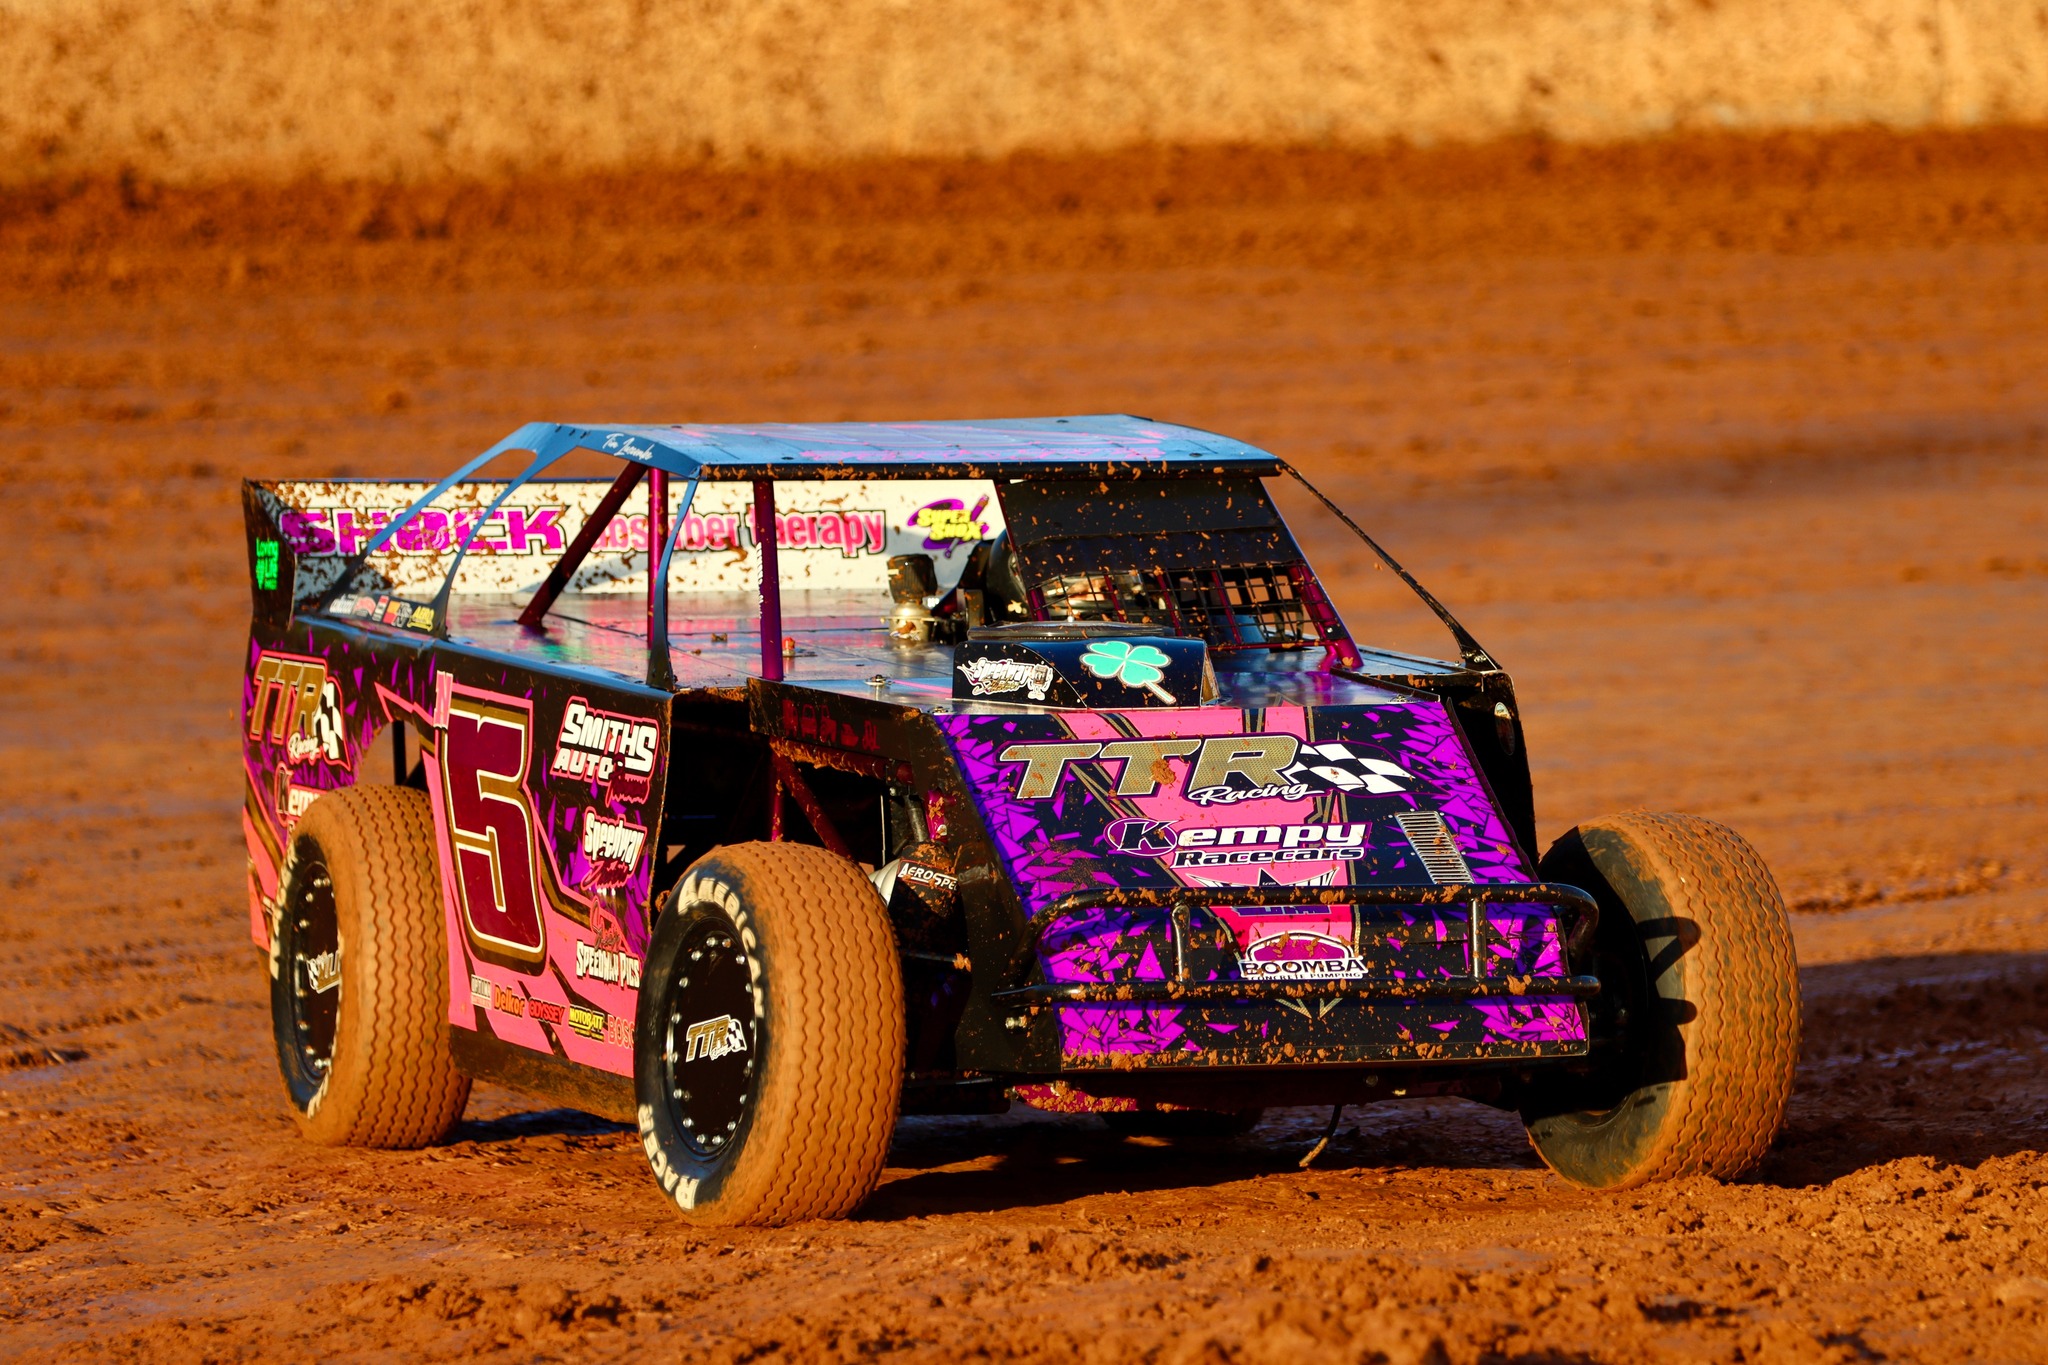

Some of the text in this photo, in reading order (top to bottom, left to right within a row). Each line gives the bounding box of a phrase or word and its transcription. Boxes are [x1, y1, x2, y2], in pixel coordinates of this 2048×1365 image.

[280, 506, 567, 555] SHOCK
[973, 658, 1035, 685] Speedway
[251, 656, 326, 739] TTR
[560, 703, 657, 773] SMITHS
[1000, 735, 1300, 800] TTR
[276, 770, 321, 817] Kem
[1187, 782, 1325, 807] Racing
[443, 707, 544, 954] 5
[584, 811, 645, 872] Speedway
[1116, 820, 1369, 853] Kempy
[1171, 846, 1364, 868] Racecars
[618, 950, 640, 988] PICS
[1241, 959, 1365, 975] BOOMBA
[493, 984, 525, 1018] Delkor
[528, 998, 566, 1025] ODYSSEY
[686, 1014, 731, 1062] TTR
[637, 1103, 700, 1210] RACER
